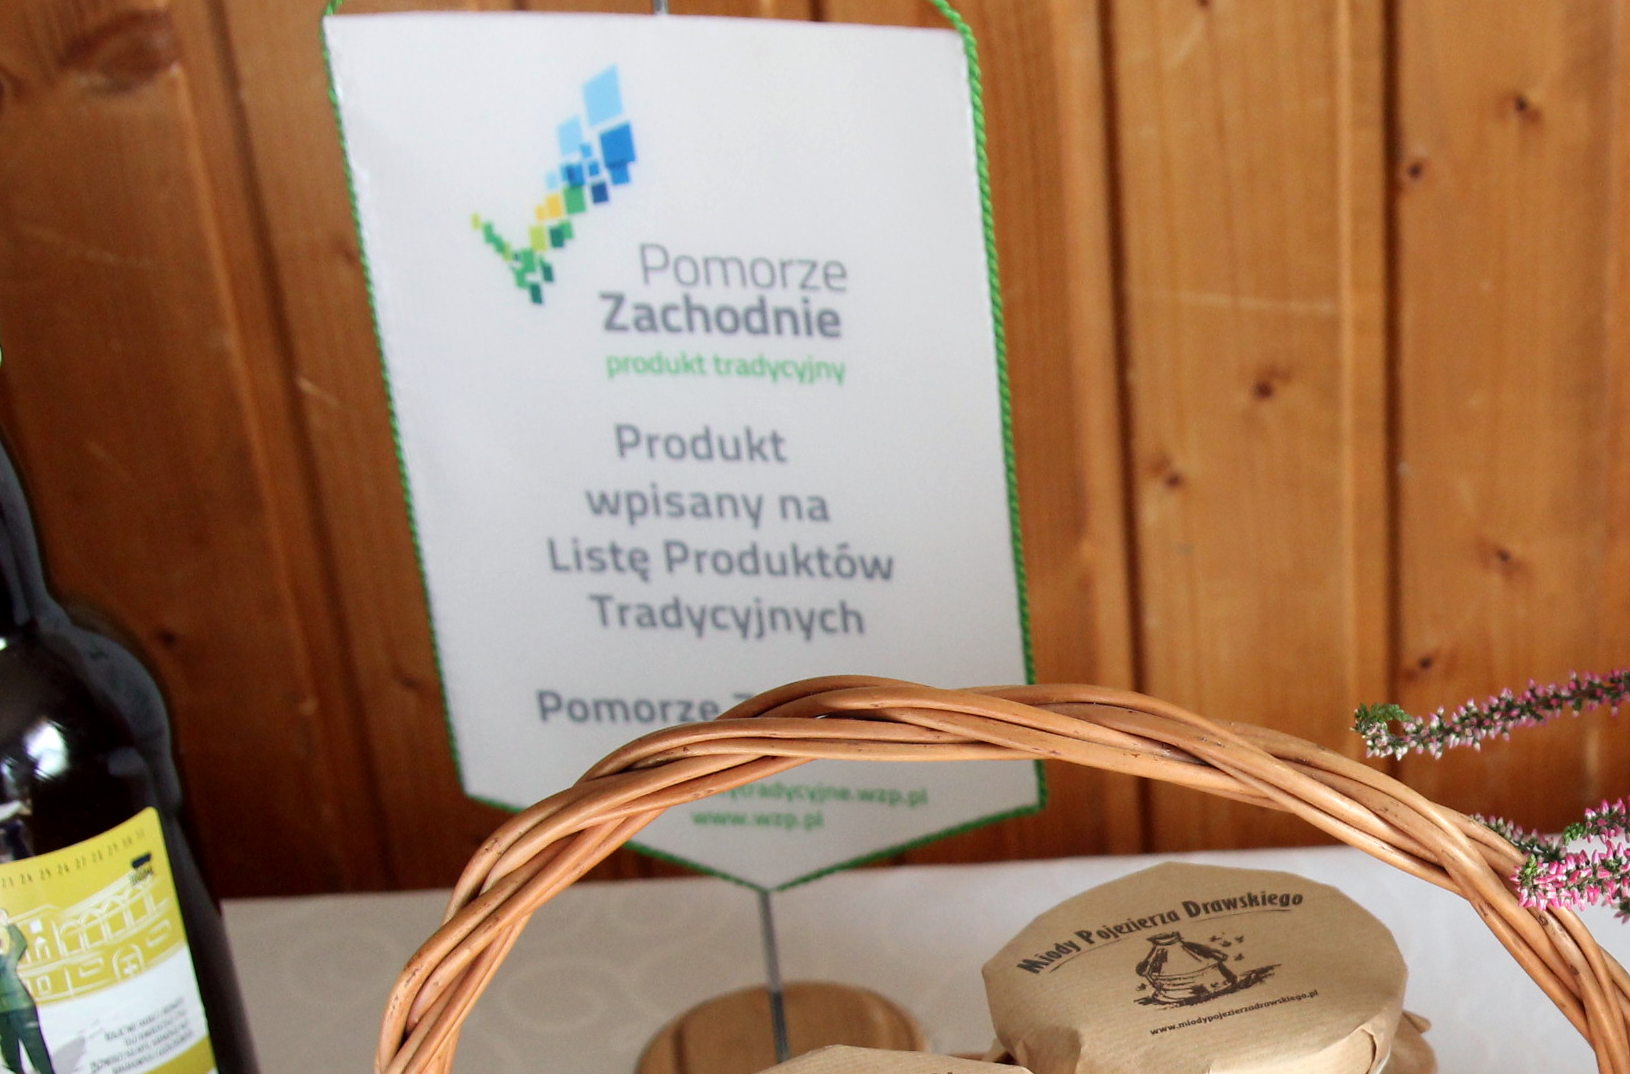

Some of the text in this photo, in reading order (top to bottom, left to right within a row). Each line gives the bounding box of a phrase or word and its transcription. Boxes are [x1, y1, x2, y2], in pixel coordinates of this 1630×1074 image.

[639, 243, 848, 293] Pomorze
[599, 291, 843, 339] Zachodnie
[605, 350, 846, 387] produkt tradycyjny
[614, 423, 788, 463] Produkt
[585, 482, 830, 530] wpisany na
[546, 537, 895, 582] Listę Produktów
[588, 595, 866, 643] Tradycyjnych
[535, 689, 720, 725] Pomorze
[691, 810, 825, 831] www.wzp.pl
[1016, 890, 1304, 976] Miody Pojezierza Drawskiego
[1149, 988, 1320, 1036] www.miodypojezierzadrawskiego.pl
